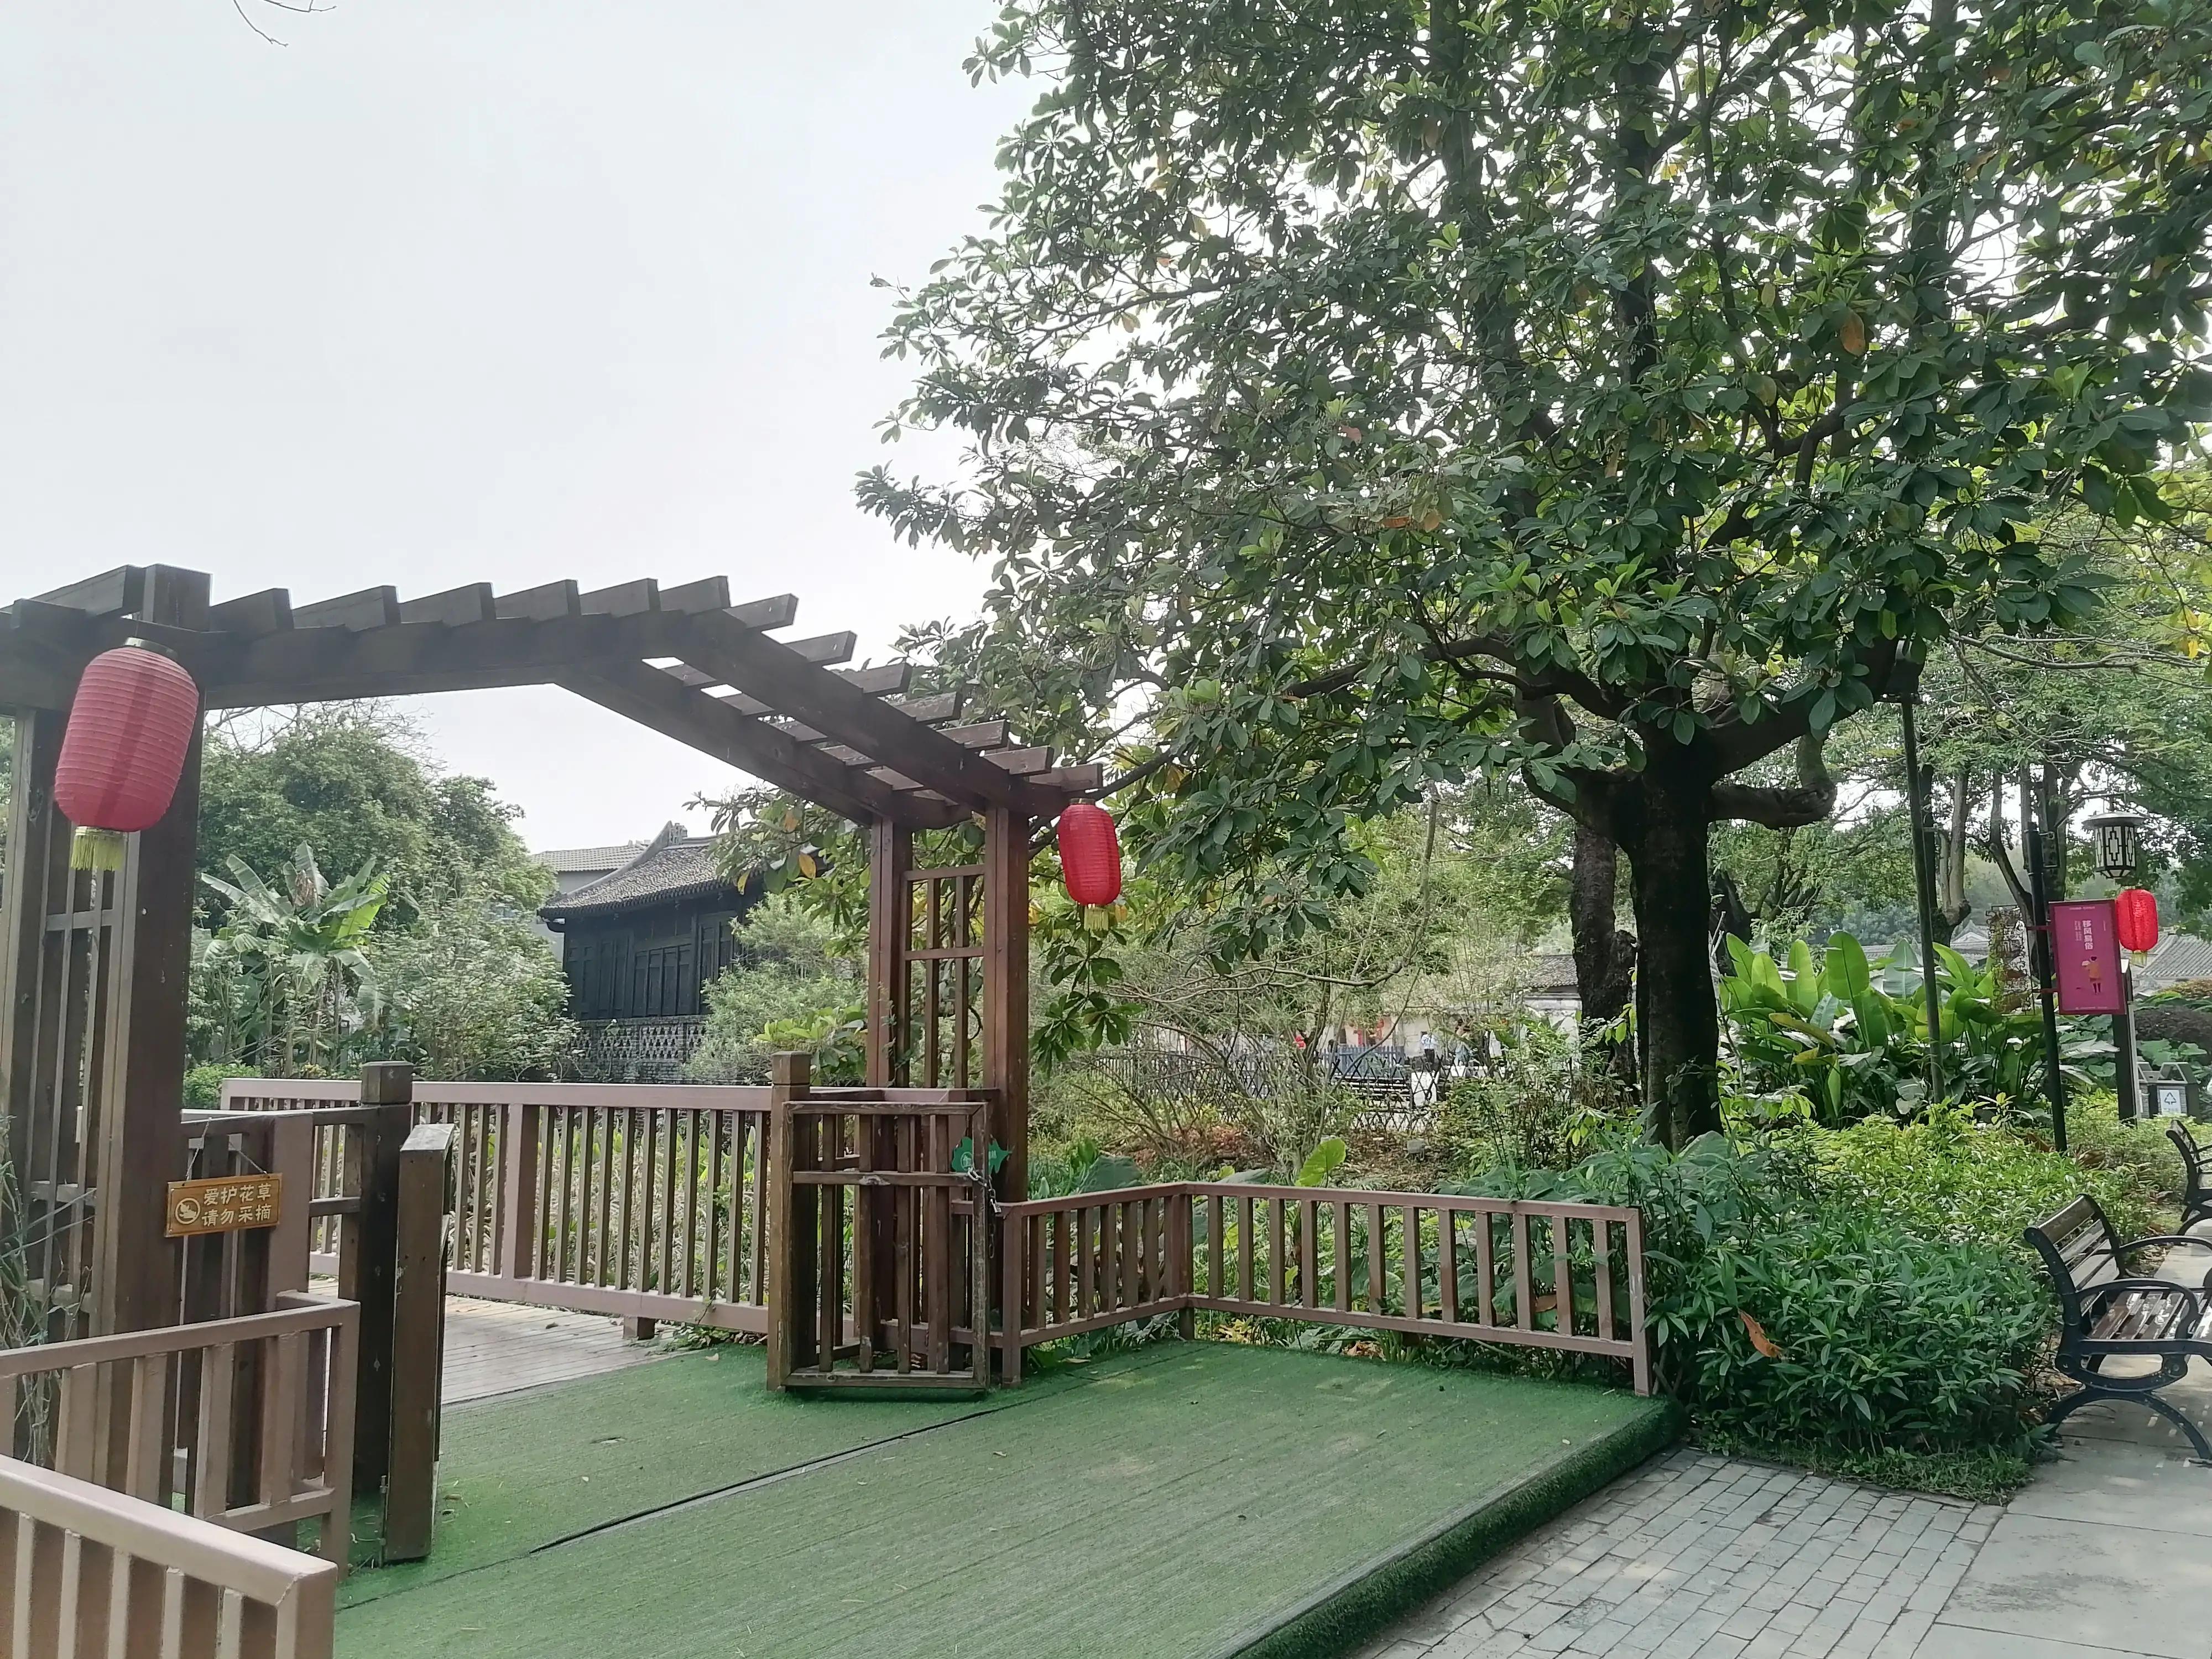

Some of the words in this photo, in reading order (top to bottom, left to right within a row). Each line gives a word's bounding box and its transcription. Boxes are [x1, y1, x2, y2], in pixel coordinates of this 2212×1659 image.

[204, 1183, 272, 1206] 爱护花草
[201, 1203, 272, 1227] 请勿采摘
